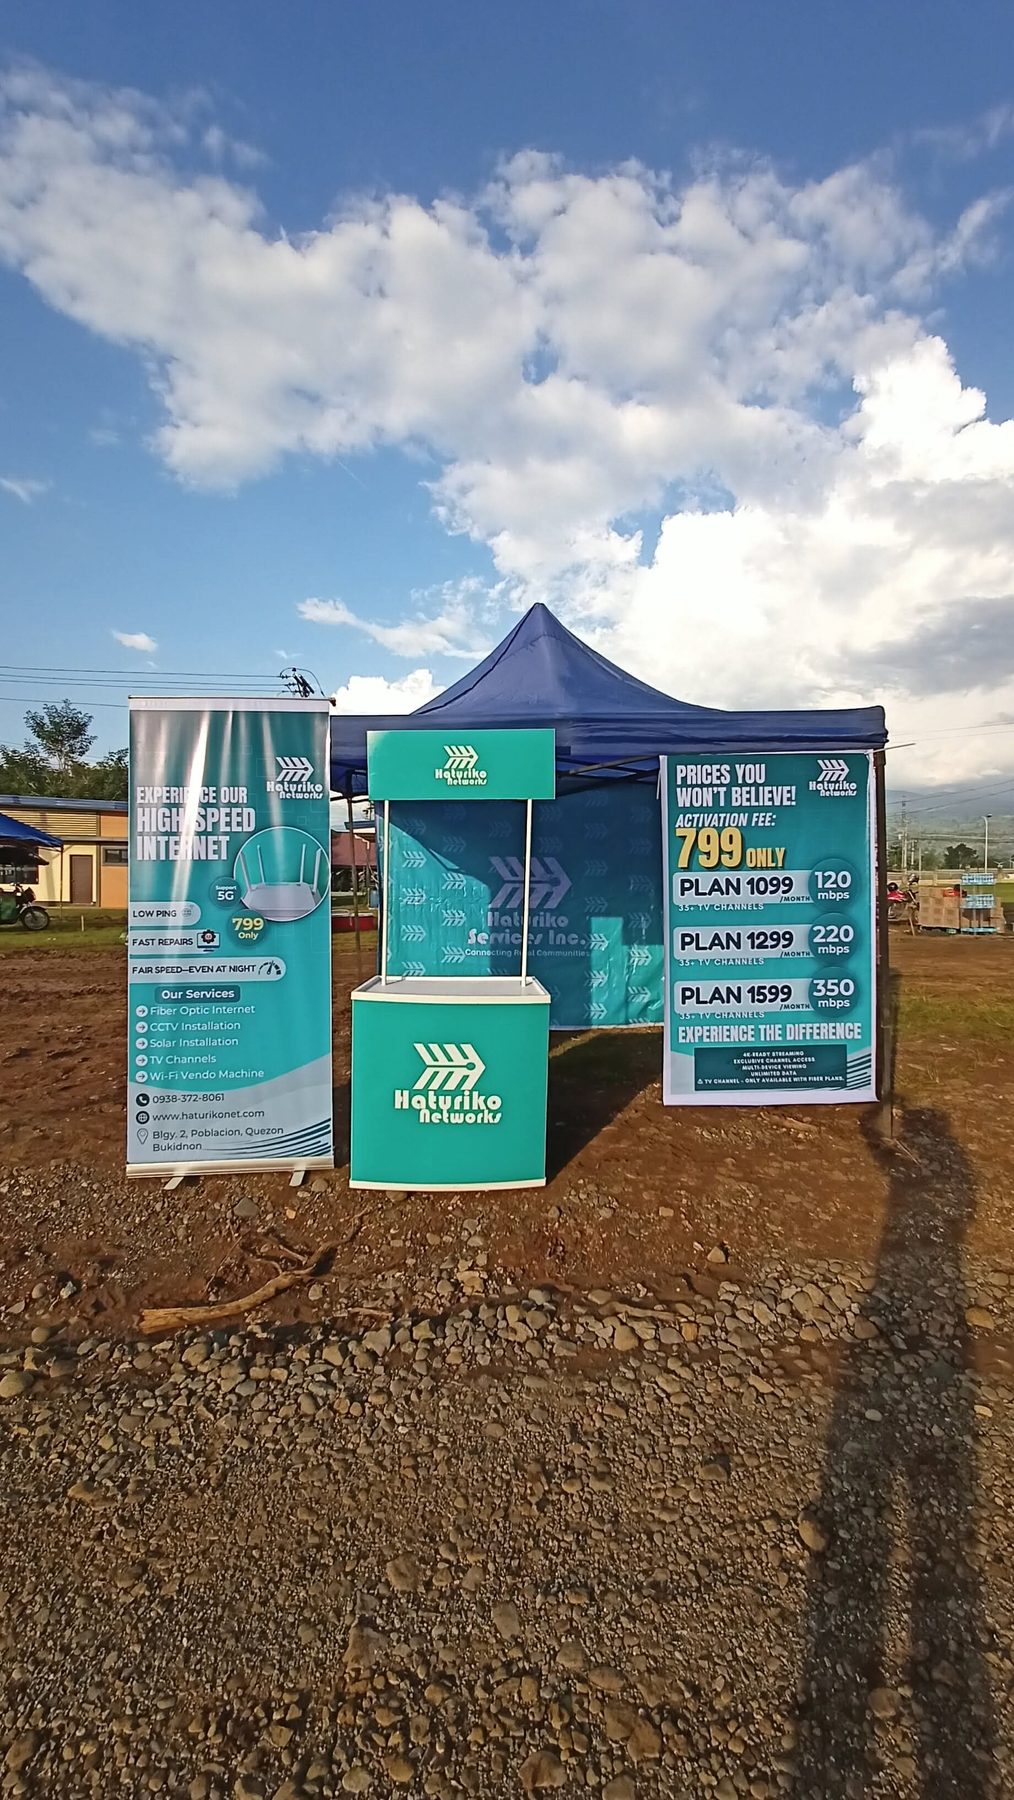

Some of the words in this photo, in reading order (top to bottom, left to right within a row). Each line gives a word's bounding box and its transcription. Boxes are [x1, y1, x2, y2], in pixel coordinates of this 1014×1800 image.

[435, 768, 487, 779] Haturiko
[676, 764, 730, 785] PRICES
[735, 764, 766, 784] YOU
[266, 781, 323, 792] Haturiko
[809, 780, 857, 791] Haturiko
[137, 787, 216, 804] EXPERIECE
[220, 787, 247, 803] OUR
[732, 786, 796, 806] BELIEVE!
[675, 813, 748, 828] ACTIVATION
[751, 813, 777, 826] FEE:
[137, 836, 230, 860] INTERNET
[676, 827, 742, 868] 799
[746, 848, 785, 868] ONLY
[815, 871, 851, 889] 120
[680, 878, 741, 896] PLAN
[746, 876, 793, 895] 1099
[217, 891, 234, 901] 5G
[780, 895, 811, 903] /MONTH
[817, 891, 850, 901] mbps
[714, 903, 765, 911] CHANNELS
[232, 918, 264, 931] 799
[488, 912, 569, 928] Hatriko
[239, 932, 258, 940] Only
[549, 930, 586, 945] Inc.
[813, 925, 854, 943] 220
[158, 938, 193, 946] REPAIRS
[680, 932, 741, 951] PLAN
[746, 930, 794, 950] 1299
[465, 949, 512, 957] Connecting
[537, 949, 590, 957] Communities
[818, 946, 850, 956] mbps
[714, 958, 765, 966] CHANNELS
[813, 979, 855, 996] 350
[162, 990, 183, 999] Our
[186, 989, 234, 999] Services
[681, 986, 741, 1005] PLAN
[747, 984, 792, 1004] 1599
[780, 1003, 811, 1011] /MONTH
[818, 999, 850, 1008] mbps
[150, 1006, 176, 1015] Fiber
[180, 1006, 209, 1016] Optic
[212, 1005, 255, 1014] Internet
[715, 1011, 765, 1020] CHANNELS
[150, 1023, 179, 1032] CCTV
[182, 1021, 241, 1031] Installation
[678, 1025, 755, 1043] EXPERIENCE
[759, 1024, 782, 1041] THE
[786, 1023, 861, 1040] DIFFERENCE
[150, 1039, 176, 1048] Solar
[179, 1037, 239, 1047] Installation
[150, 1056, 163, 1064] TV
[166, 1054, 216, 1064] Channels
[150, 1072, 178, 1081] Wi-Fi
[181, 1071, 216, 1080] Vendo
[219, 1070, 264, 1079] Machine
[152, 1093, 225, 1104] 0938-372-8061
[394, 1090, 502, 1110] Haturiko
[152, 1110, 265, 1121] www.haturikonet.com
[179, 1130, 188, 1138] 2,
[191, 1128, 243, 1138] Poblacion,
[245, 1127, 284, 1136] Quezon
[153, 1143, 202, 1151] Bukidnon
